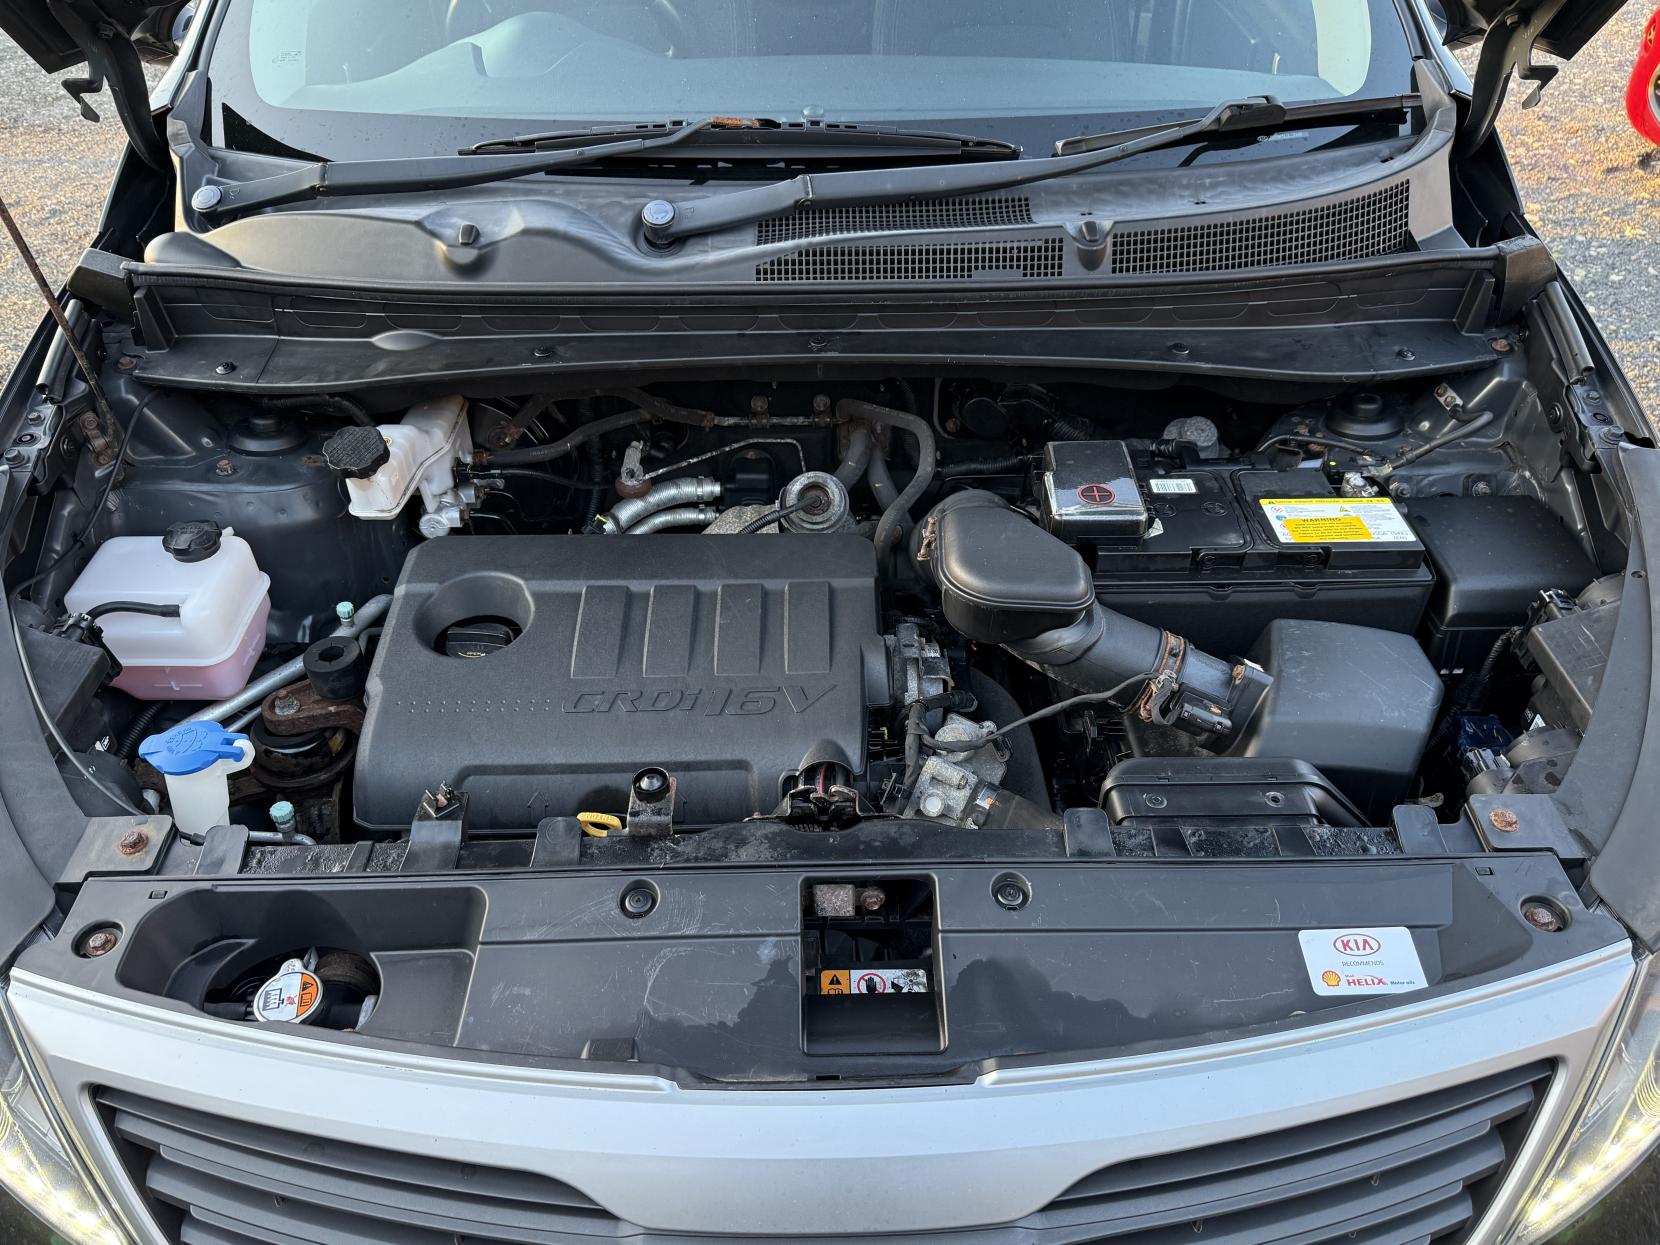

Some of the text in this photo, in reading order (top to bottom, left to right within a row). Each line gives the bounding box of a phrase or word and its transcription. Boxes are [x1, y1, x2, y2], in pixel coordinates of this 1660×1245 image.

[561, 684, 838, 716] CRDi 16V
[1340, 939, 1374, 951] KIA
[1347, 977, 1387, 987] HELIX
